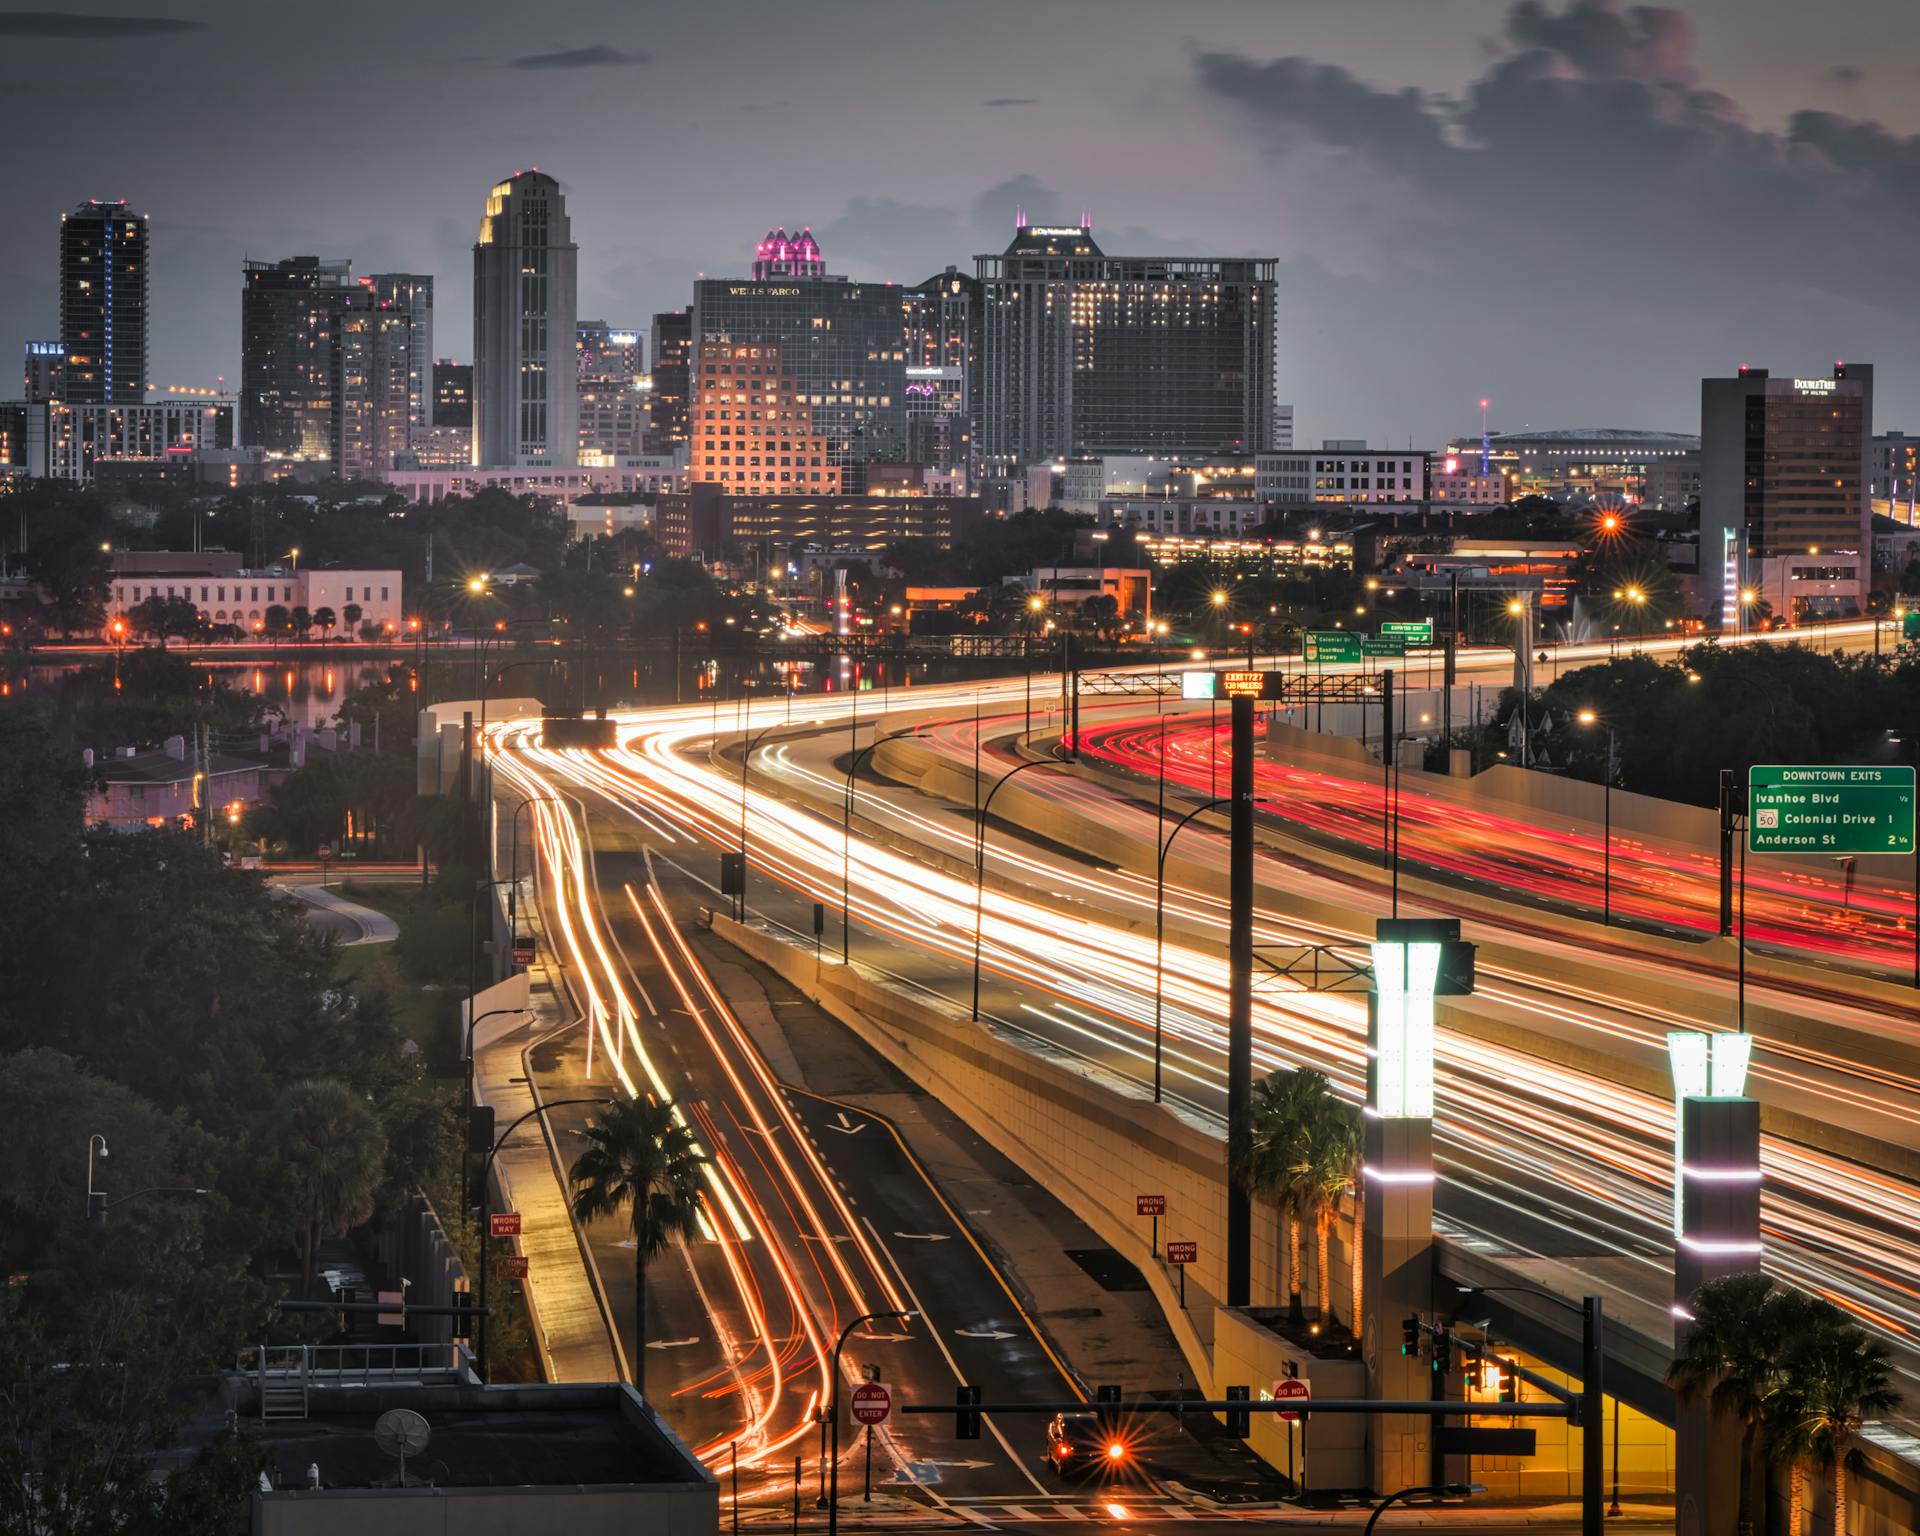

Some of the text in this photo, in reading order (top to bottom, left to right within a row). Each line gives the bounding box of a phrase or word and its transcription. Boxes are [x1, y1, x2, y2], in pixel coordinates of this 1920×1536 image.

[729, 287, 800, 296] WELLS FARGO
[1783, 771, 1882, 781] DOWNTOWN EXITS
[1756, 794, 1806, 803] Ivanhoe
[1812, 794, 1840, 803] Blvd
[1760, 814, 1893, 825] 50 Colonial Drive 1
[1756, 835, 1816, 844] Anderson
[1822, 835, 1836, 844] St
[1888, 836, 1896, 845] 2
